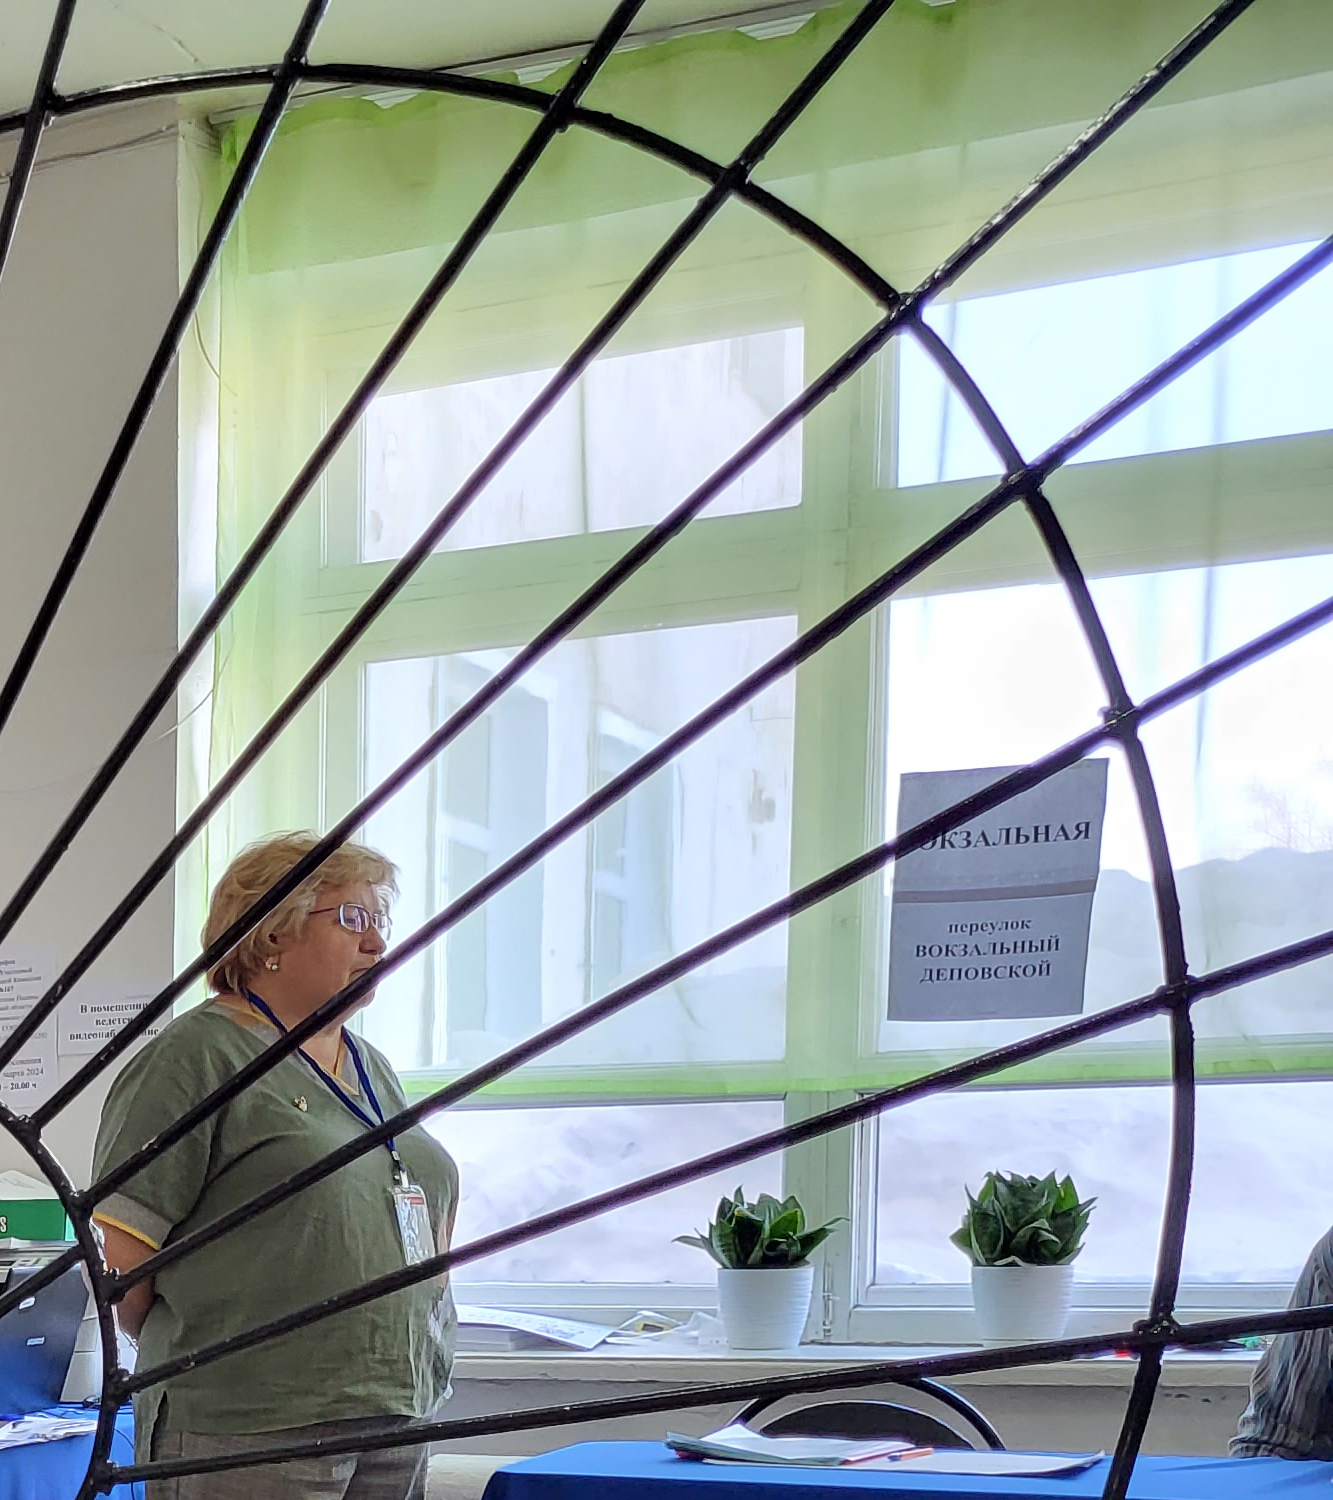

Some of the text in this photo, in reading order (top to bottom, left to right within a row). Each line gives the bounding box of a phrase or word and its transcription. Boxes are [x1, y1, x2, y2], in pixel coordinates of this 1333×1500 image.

[917, 820, 1091, 852] ОКЗАЛЬНАЯ
[947, 918, 1033, 936] переулок
[915, 934, 1061, 959] ВОКЗАЛЬНЫЙ
[919, 960, 1052, 985] ДЕПОВСКОЙ
[80, 1004, 87, 1013] В
